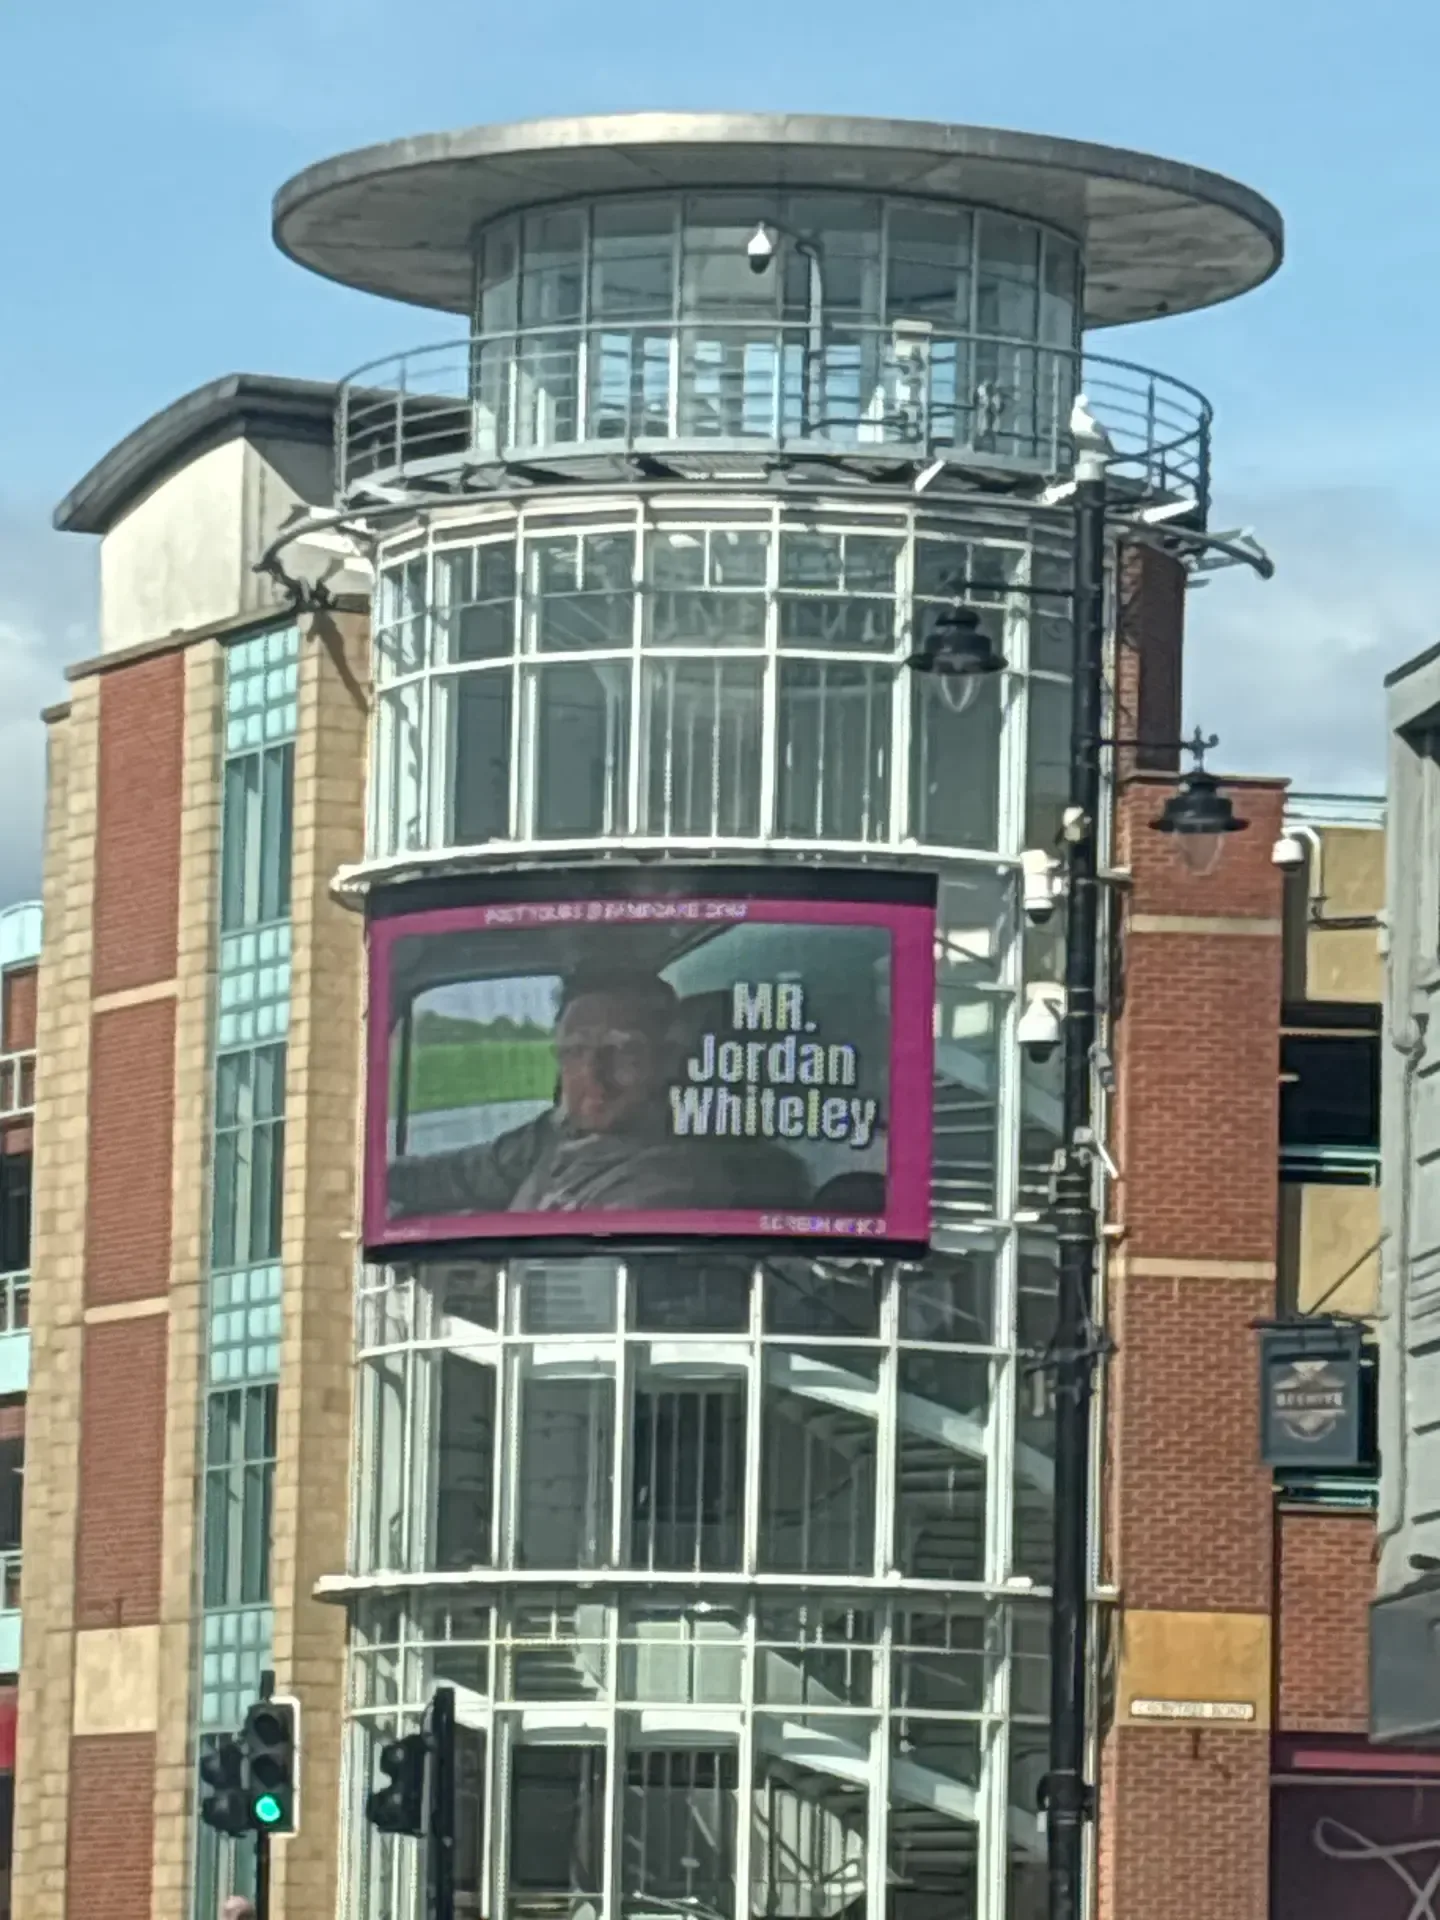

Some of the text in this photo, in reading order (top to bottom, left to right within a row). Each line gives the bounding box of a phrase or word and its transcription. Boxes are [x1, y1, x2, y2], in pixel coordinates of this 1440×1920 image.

[732, 981, 818, 1031] MR.
[687, 1033, 856, 1085] Jordan
[669, 1084, 877, 1147] Whiteley
